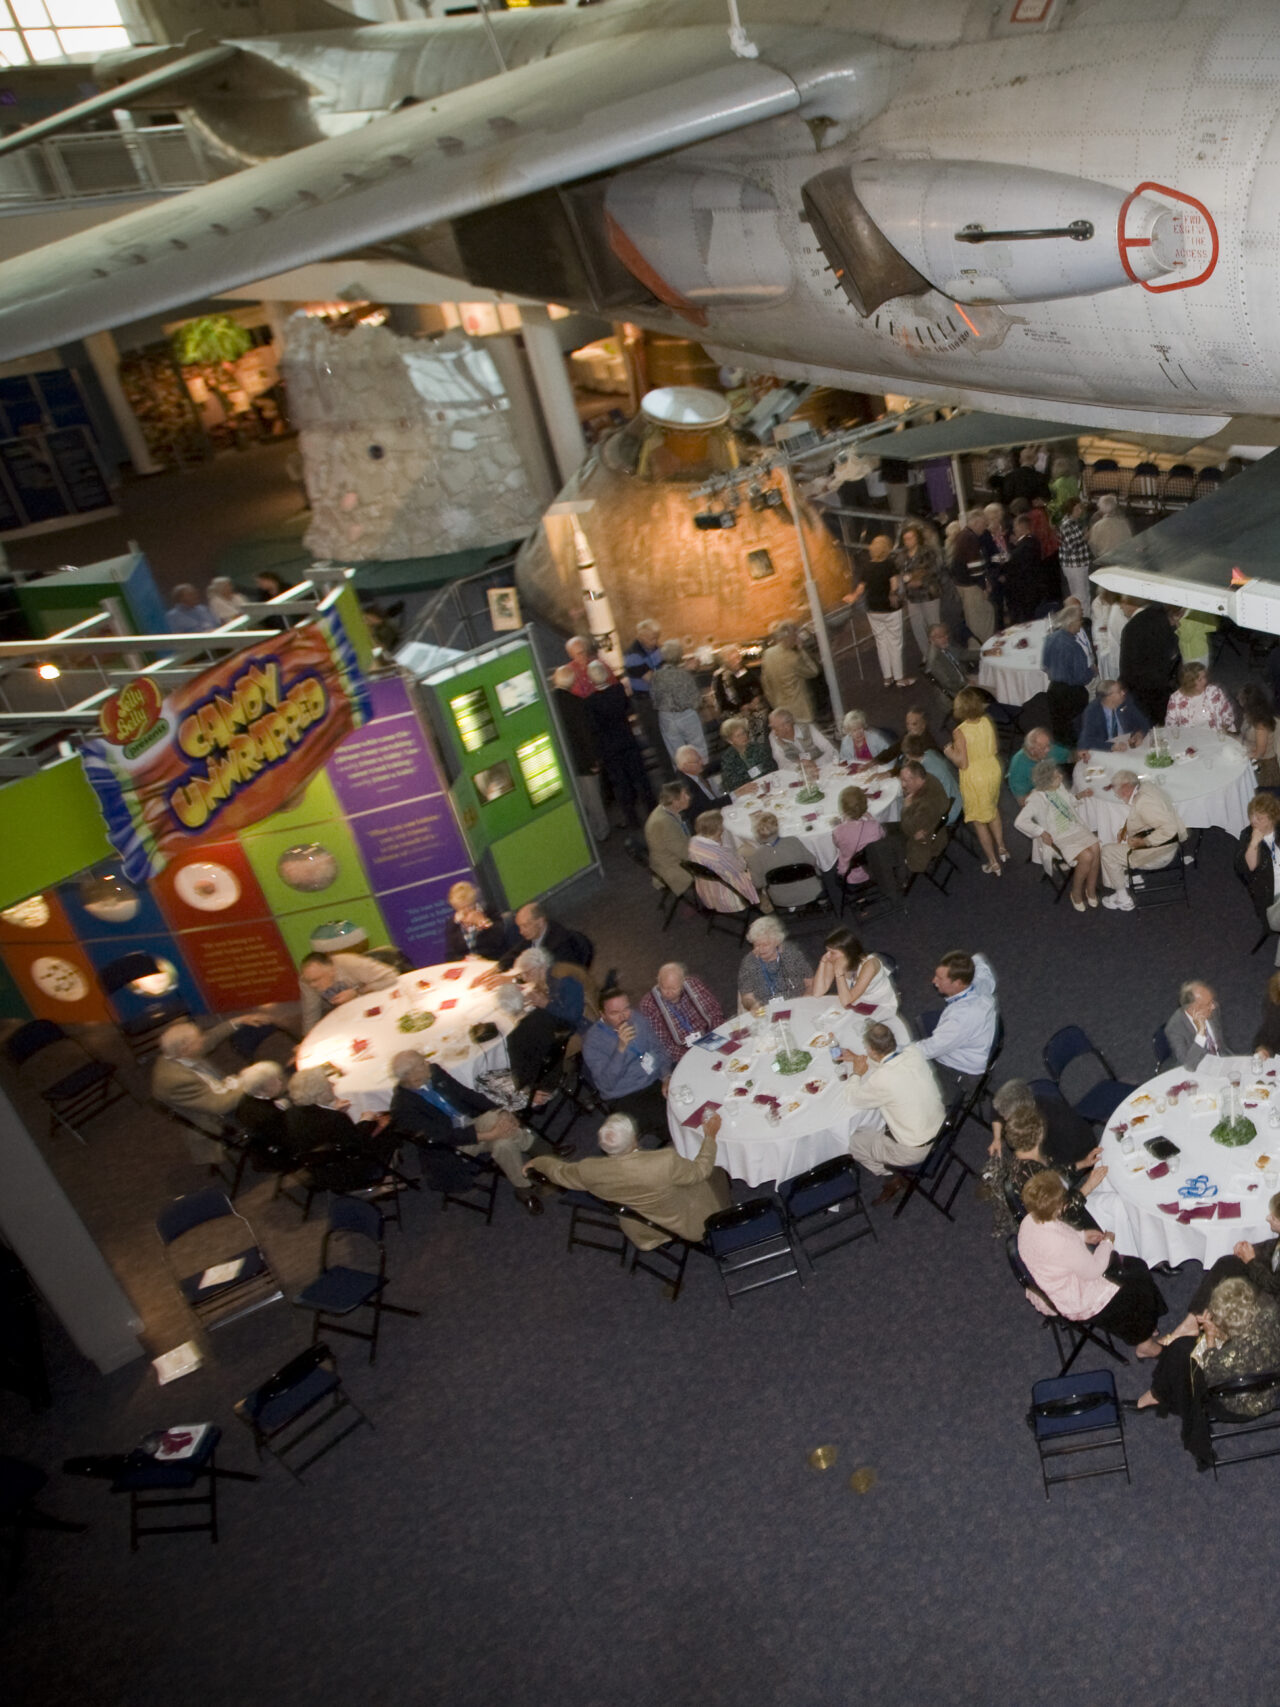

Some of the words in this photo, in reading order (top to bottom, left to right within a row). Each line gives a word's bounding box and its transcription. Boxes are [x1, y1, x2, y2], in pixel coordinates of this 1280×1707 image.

[117, 708, 148, 741] Belly
[170, 677, 326, 828] UNWRAPPED
[178, 662, 278, 758] CANDY
